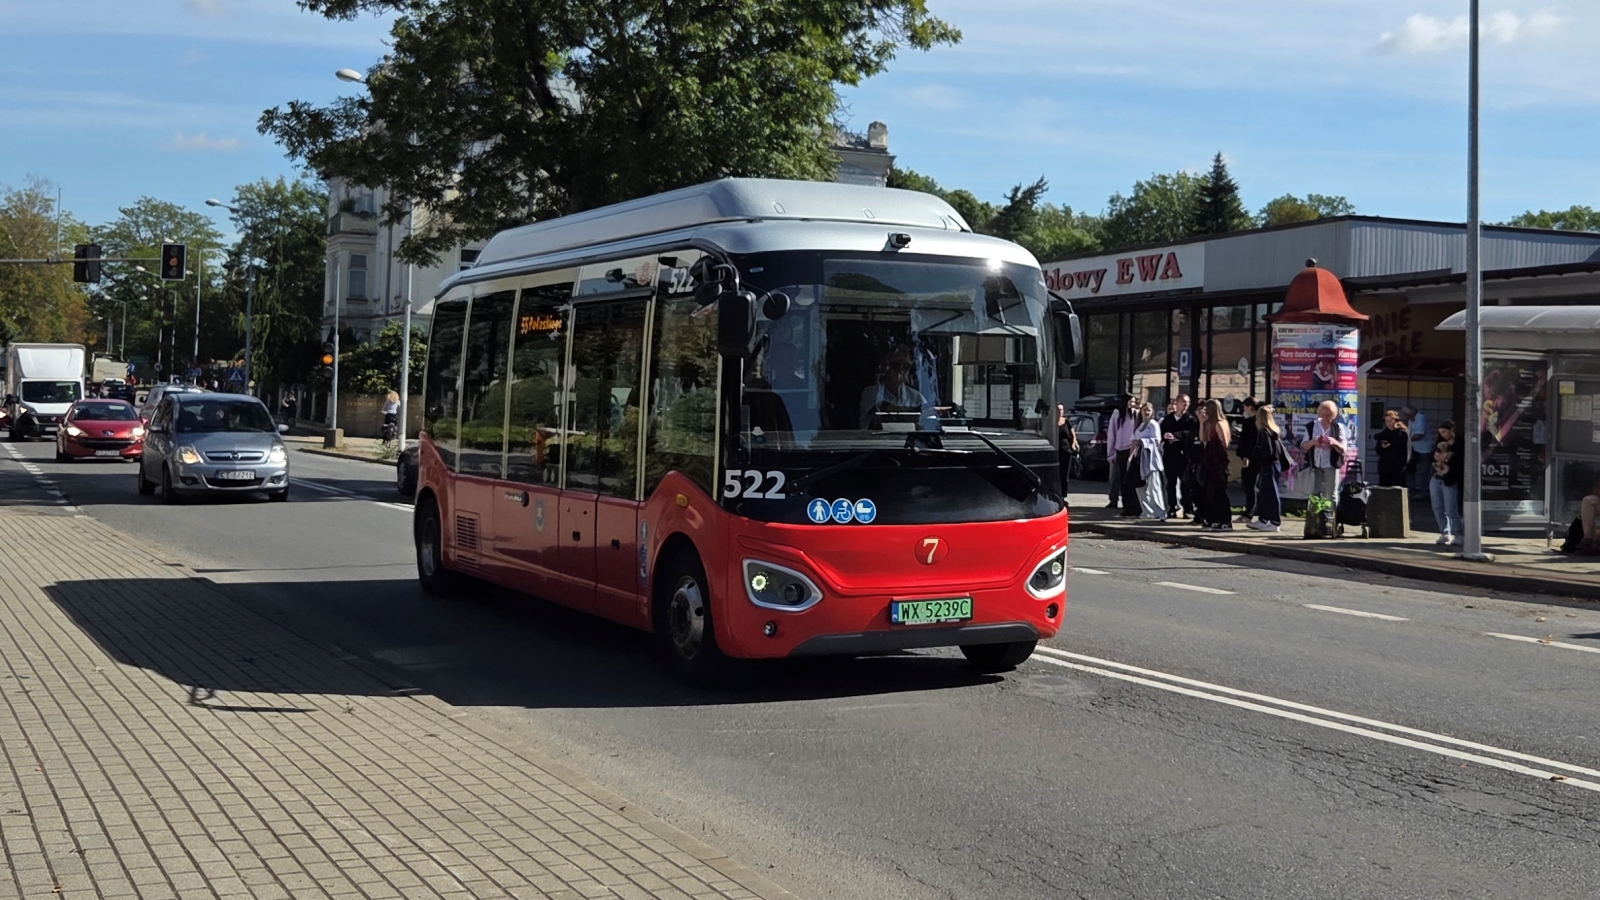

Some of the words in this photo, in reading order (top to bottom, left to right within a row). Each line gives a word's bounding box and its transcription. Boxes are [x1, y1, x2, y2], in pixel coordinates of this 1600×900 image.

[668, 268, 694, 294] 522
[1115, 252, 1183, 285] EWA
[1179, 351, 1189, 373] P
[1481, 464, 1510, 476] 10-31
[723, 469, 786, 499] 522
[923, 538, 939, 564] 7
[901, 603, 920, 620] WX
[925, 600, 969, 618] 5239C
